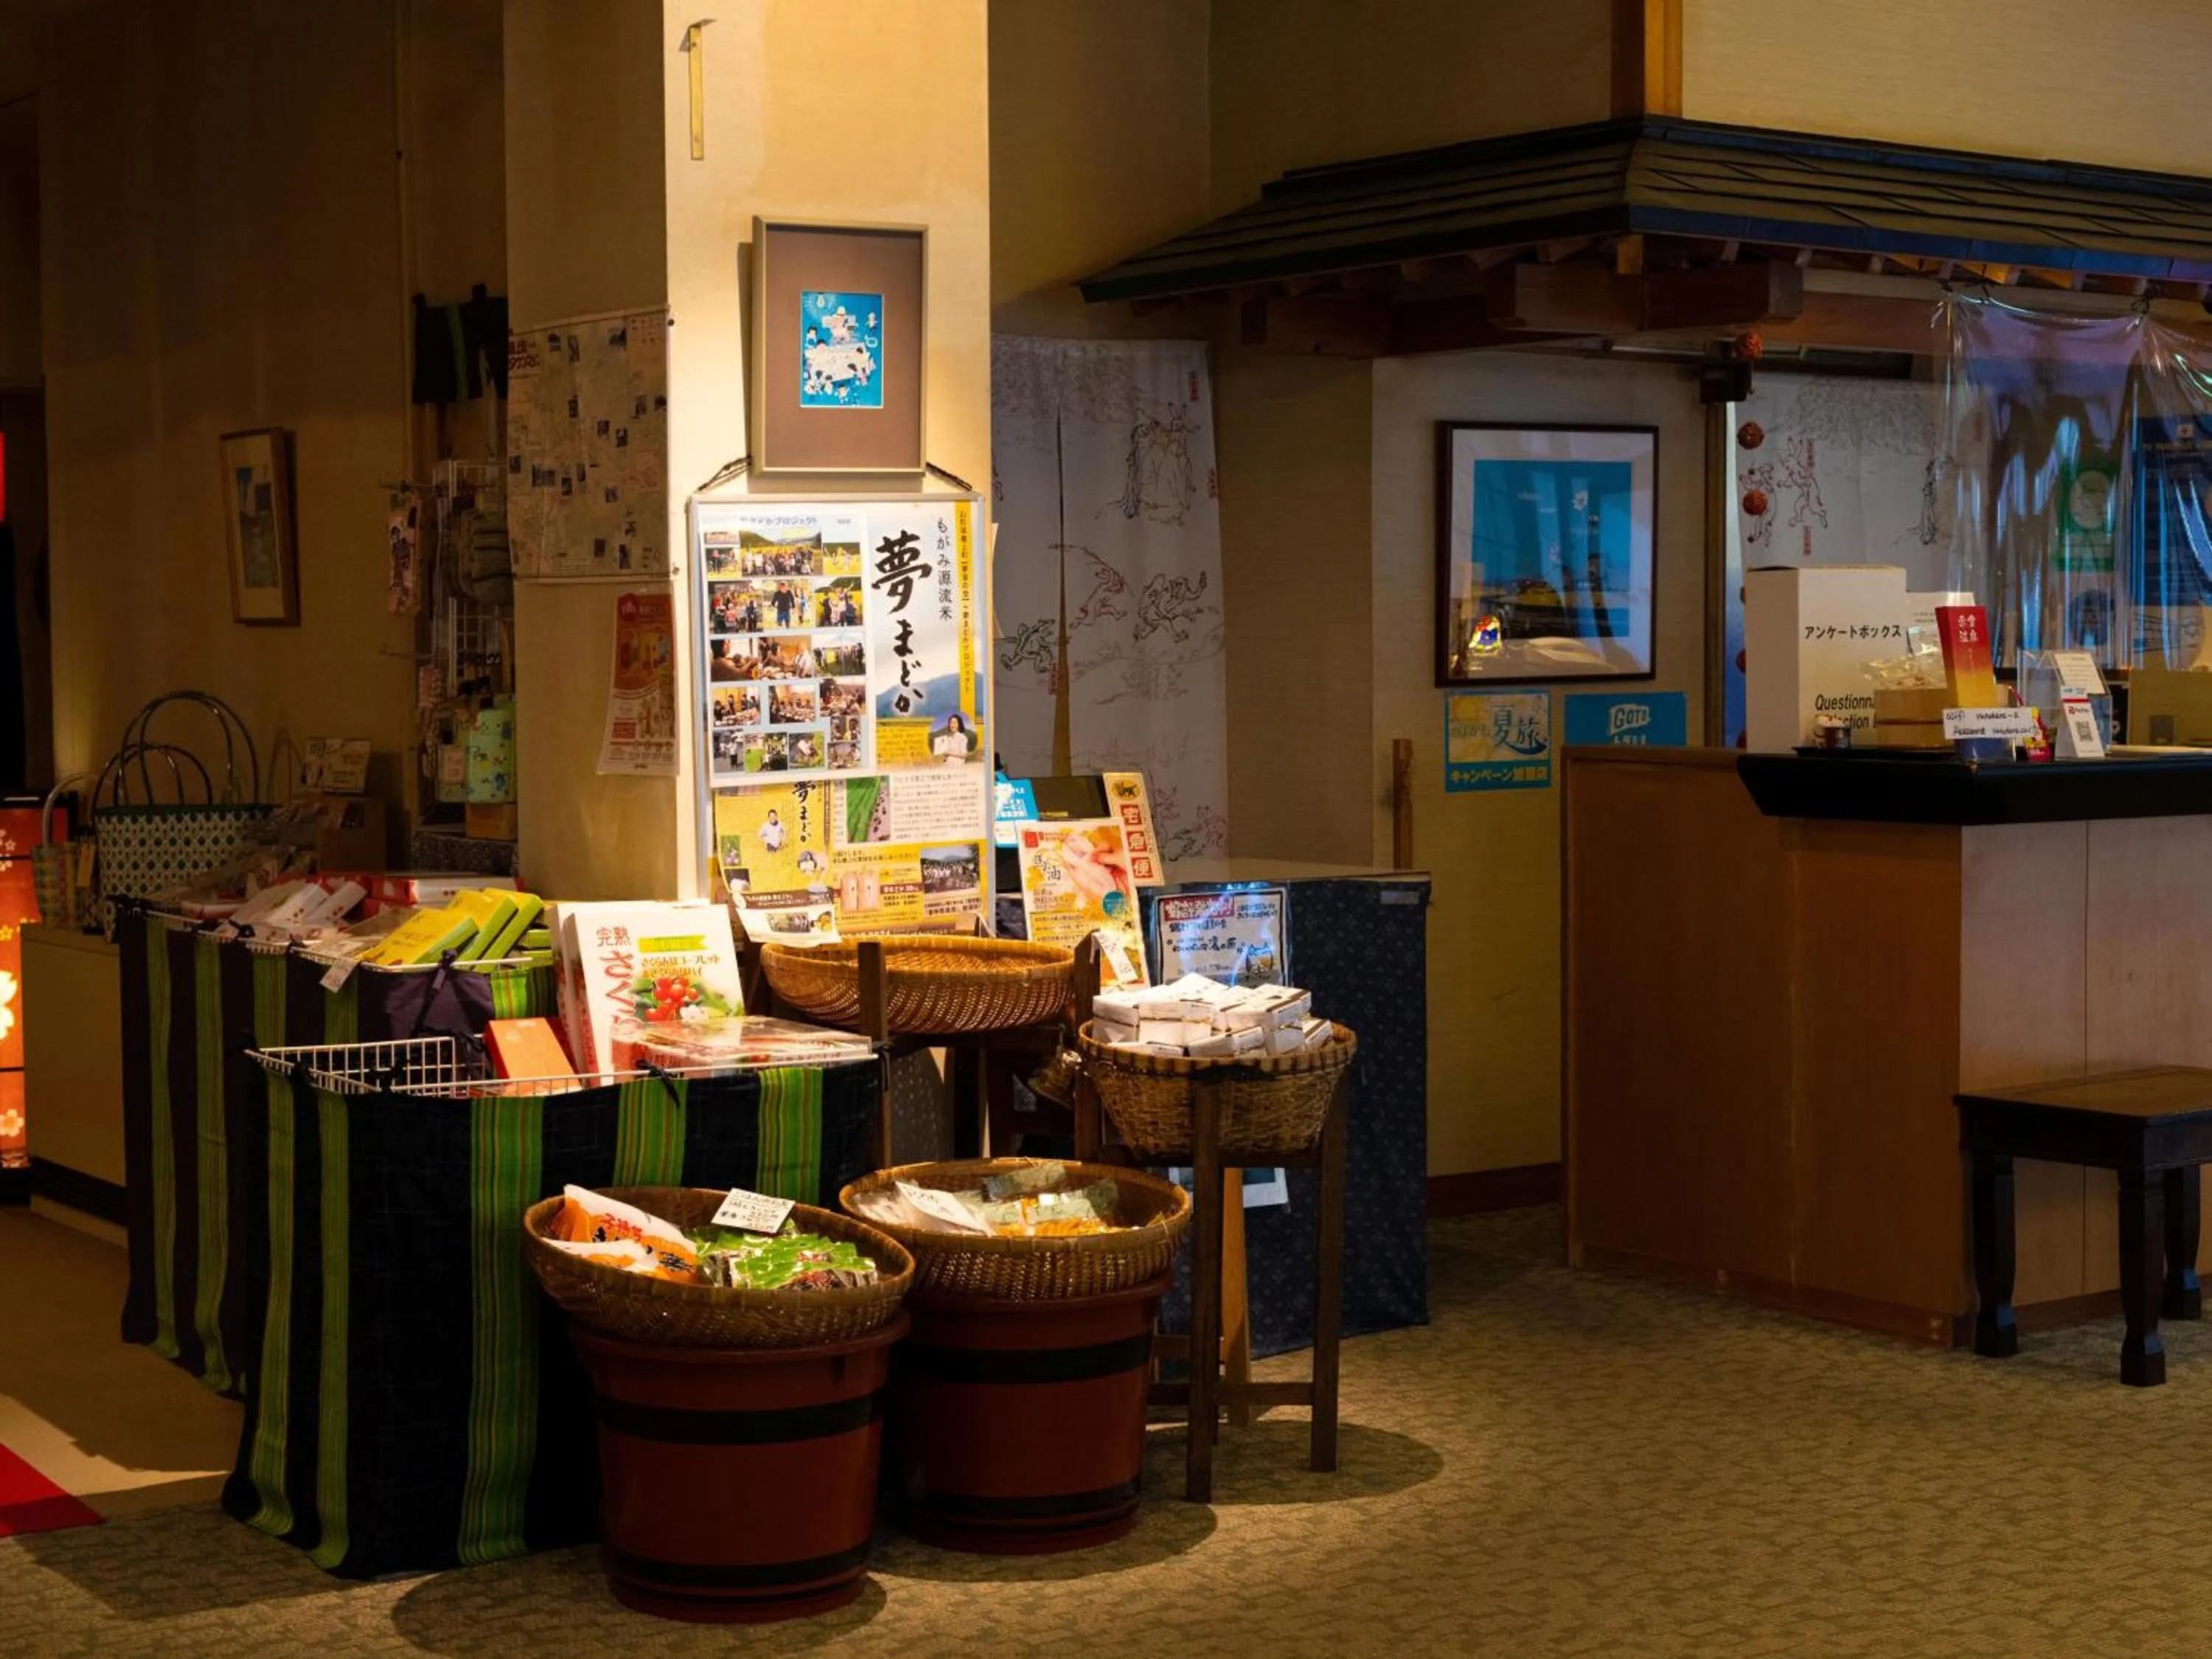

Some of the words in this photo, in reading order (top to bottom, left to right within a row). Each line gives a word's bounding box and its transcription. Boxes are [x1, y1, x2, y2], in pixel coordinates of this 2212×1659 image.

[936, 518, 953, 621] もがみ源流米
[871, 529, 933, 714] 夢まどか
[1805, 625, 1902, 639] アンケートボックス
[1122, 805, 1152, 878] 宅急便
[596, 926, 632, 947] 完熟
